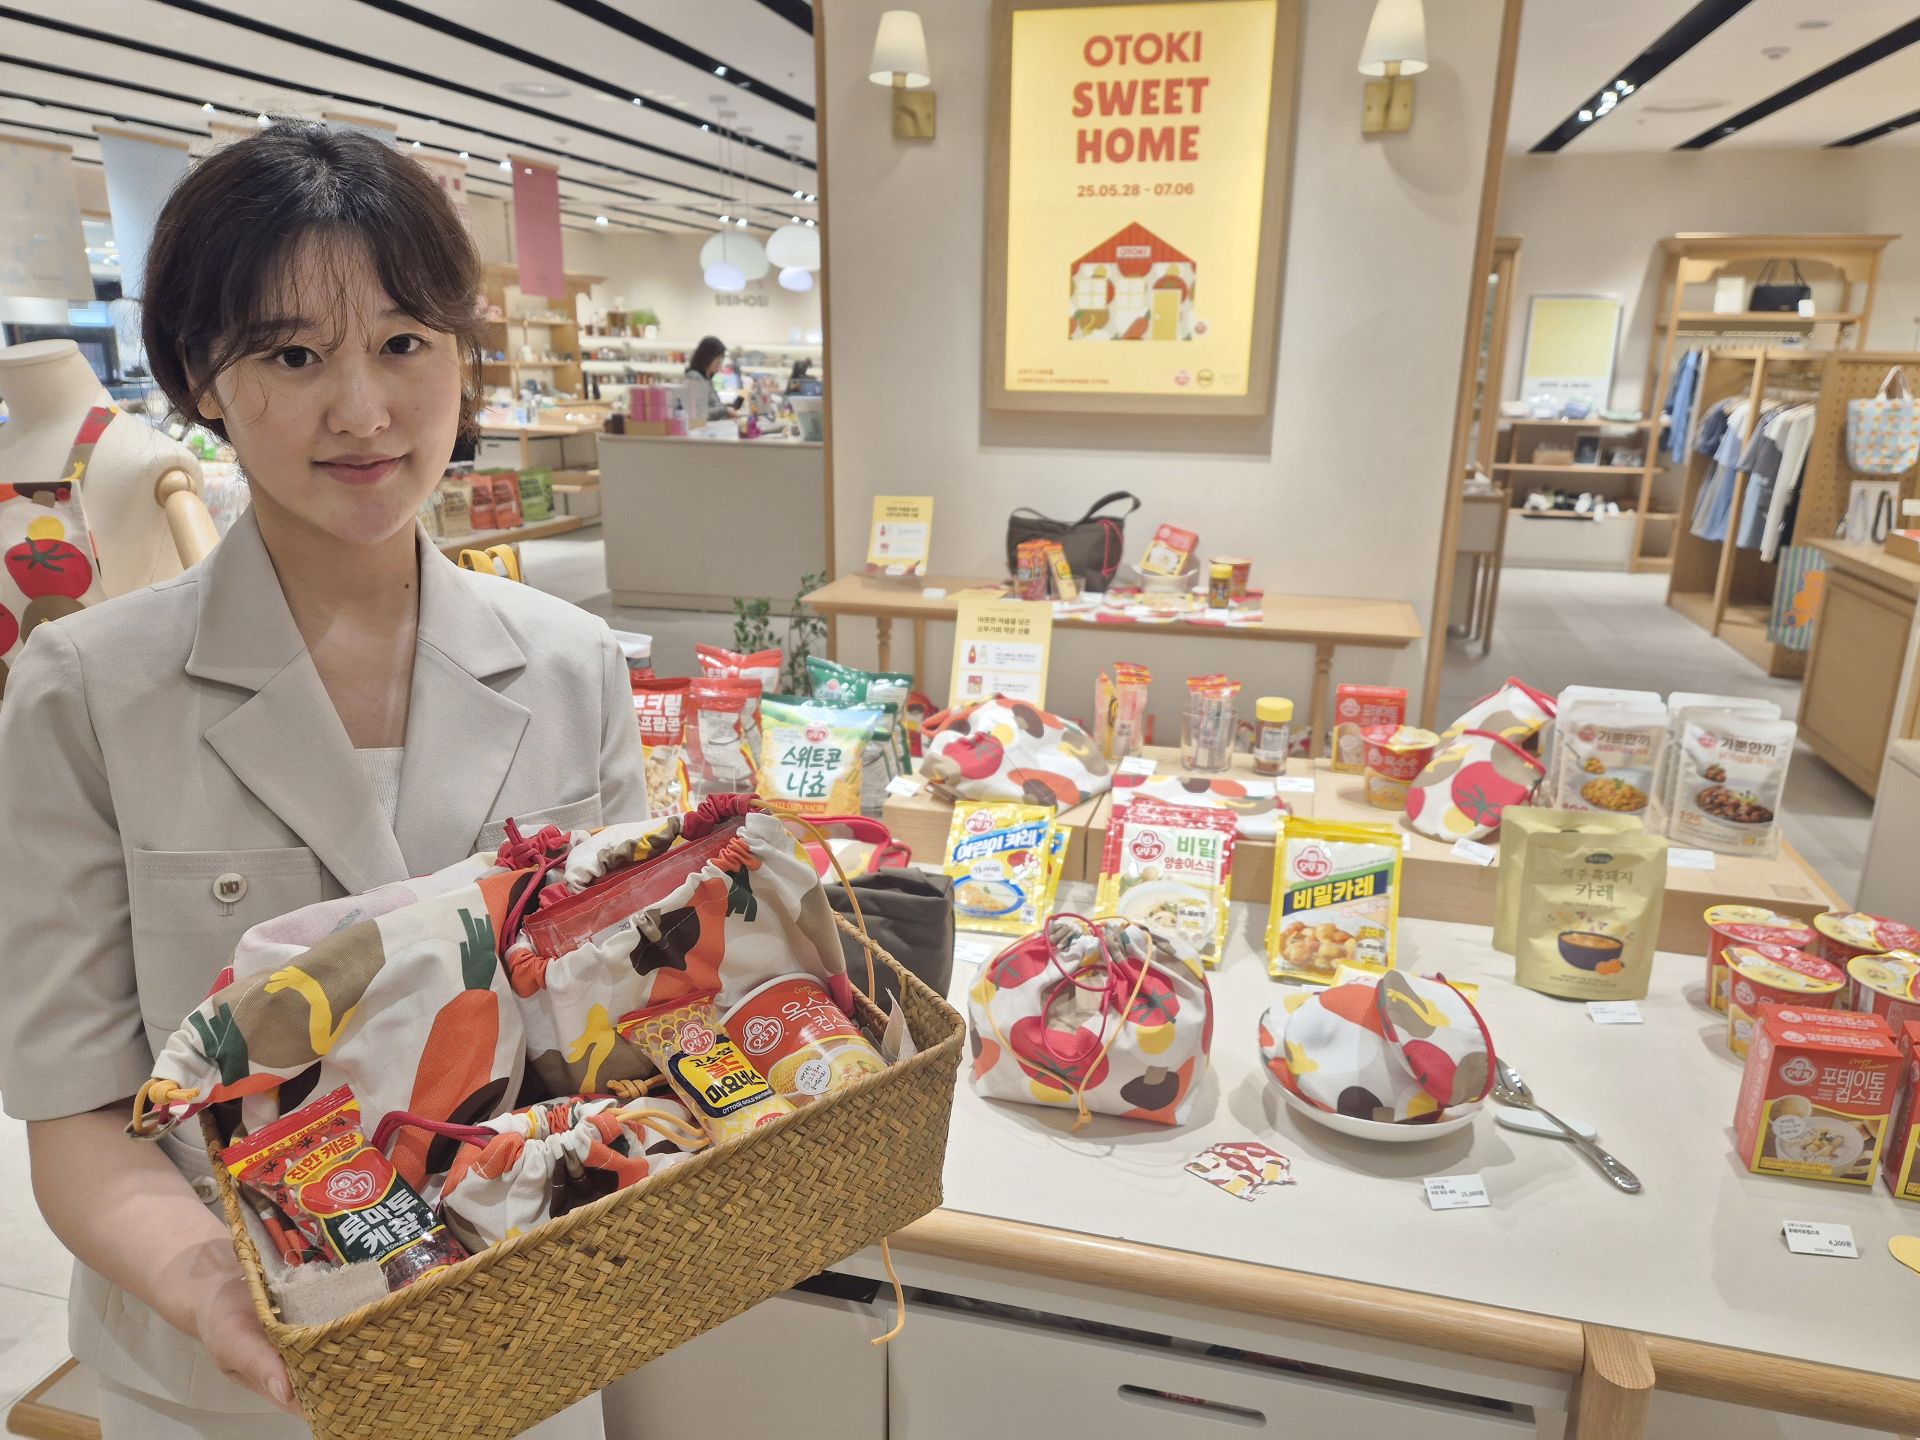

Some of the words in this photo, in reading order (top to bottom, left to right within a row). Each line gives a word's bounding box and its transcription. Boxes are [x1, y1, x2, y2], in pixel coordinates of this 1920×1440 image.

[1084, 31, 1202, 67] OTOKI
[1072, 77, 1209, 118] SWEET
[1076, 126, 1199, 164] HOME
[1077, 184, 1140, 197] 25.05.28
[1154, 183, 1194, 196] 07.06
[780, 745, 842, 770] 스위트콘
[1720, 736, 1776, 757] 가뿐한끼
[786, 771, 827, 797] 나쵸
[955, 835, 1003, 861] 어린이
[1004, 829, 1037, 848] 카레
[1177, 836, 1216, 858] 비밀
[1293, 873, 1376, 910] 비밀카레
[1575, 884, 1615, 902] 카레
[752, 1024, 779, 1050] 오뚜기
[705, 1054, 745, 1079] 골드
[1820, 1067, 1886, 1090] 포테이토
[704, 1070, 767, 1104] 마요네스
[1835, 1087, 1882, 1103] 컵스프
[286, 1153, 322, 1181] 진한
[336, 1180, 369, 1199] 오뚜기
[338, 1189, 419, 1246] 토마토
[1828, 1239, 1852, 1248] 4,200원
